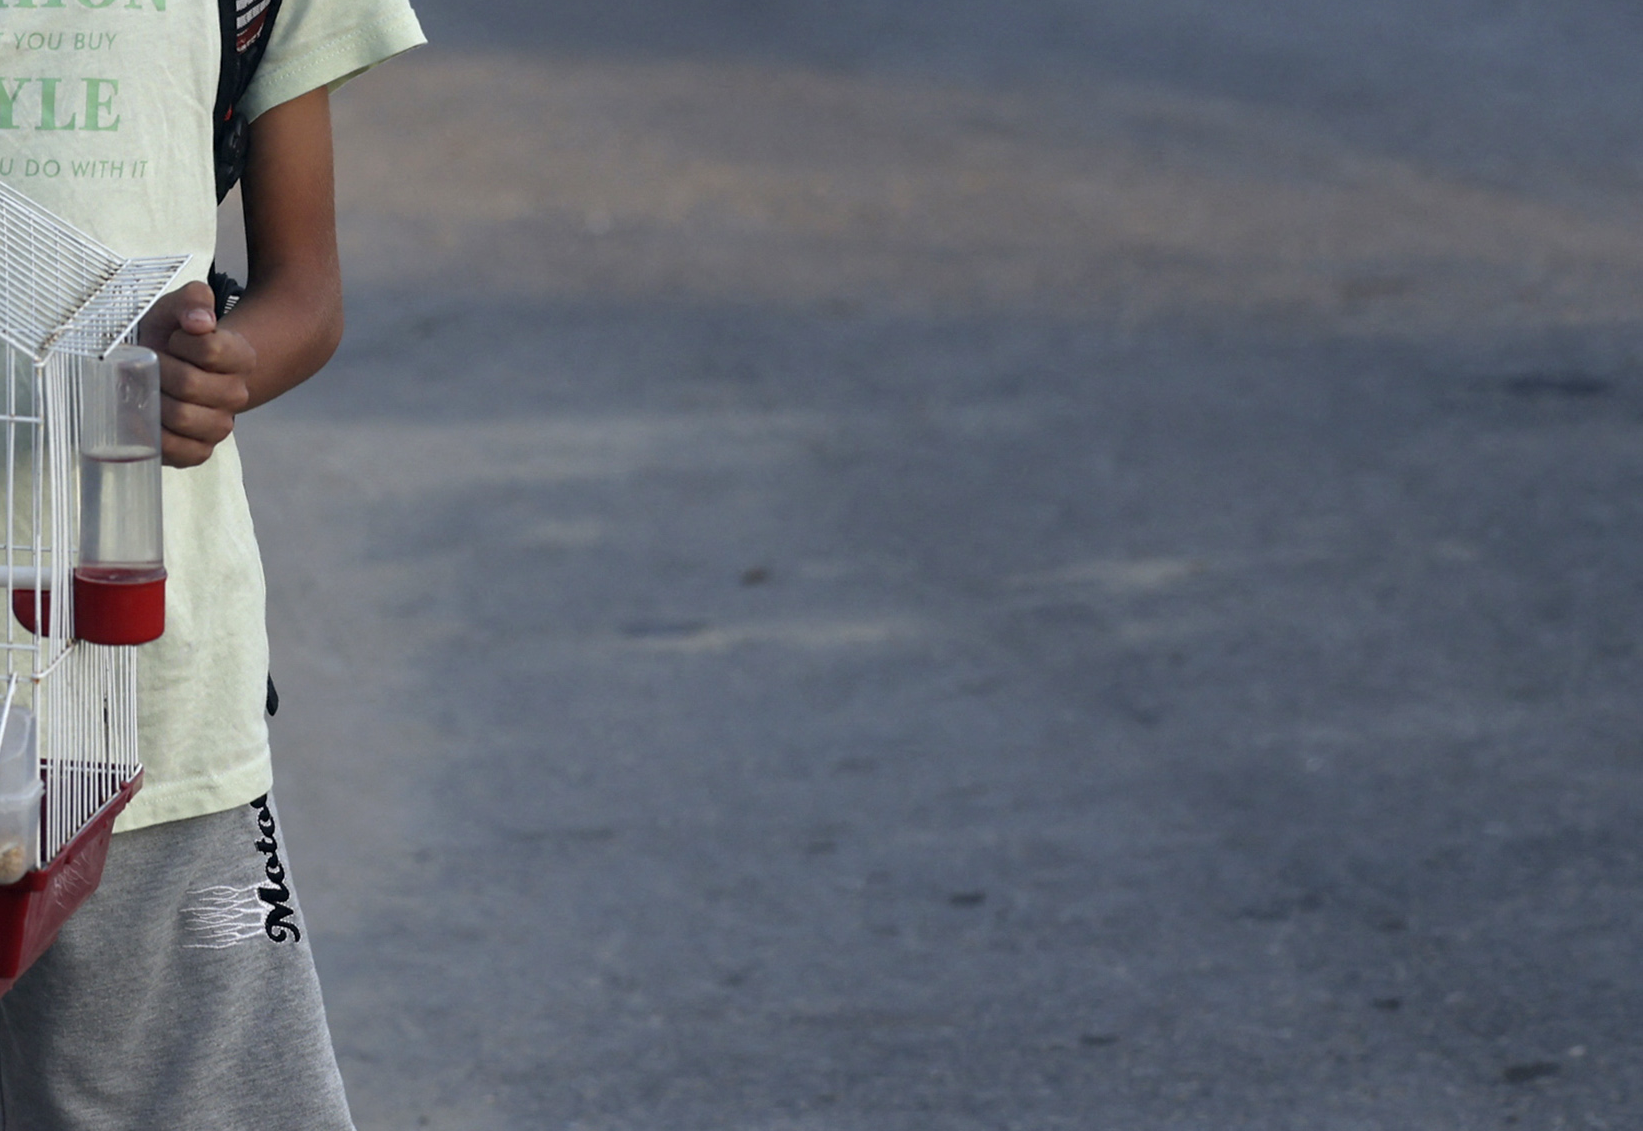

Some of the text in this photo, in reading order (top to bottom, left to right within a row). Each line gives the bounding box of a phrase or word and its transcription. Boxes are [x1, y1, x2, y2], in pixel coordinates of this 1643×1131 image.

[13, 32, 63, 50] YOU
[74, 32, 117, 50] BUY
[25, 159, 61, 178] DO
[72, 160, 124, 178] WITH
[132, 160, 149, 178] IT
